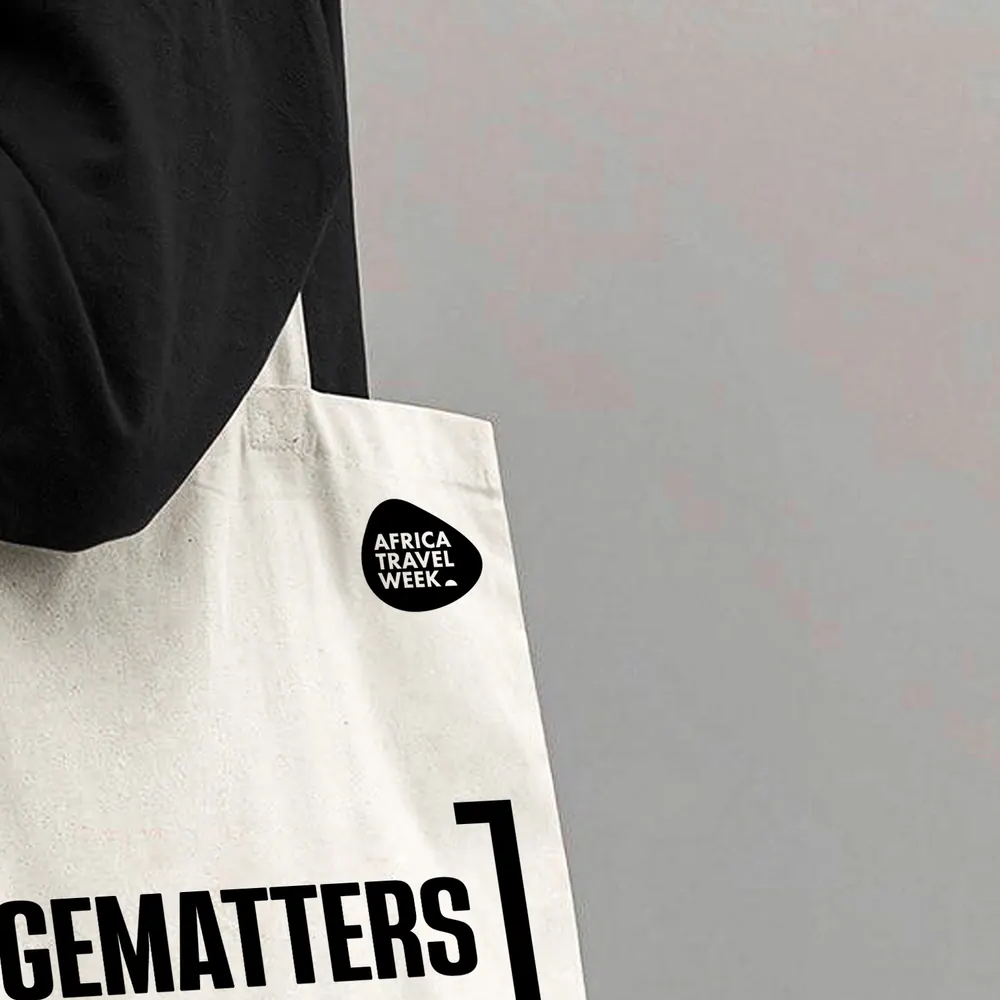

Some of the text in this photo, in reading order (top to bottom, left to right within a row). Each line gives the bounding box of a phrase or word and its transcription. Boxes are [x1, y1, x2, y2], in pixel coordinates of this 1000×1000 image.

[374, 531, 452, 551] AFRICA
[375, 550, 455, 570] TRAVEL
[378, 570, 442, 589] WEEK
